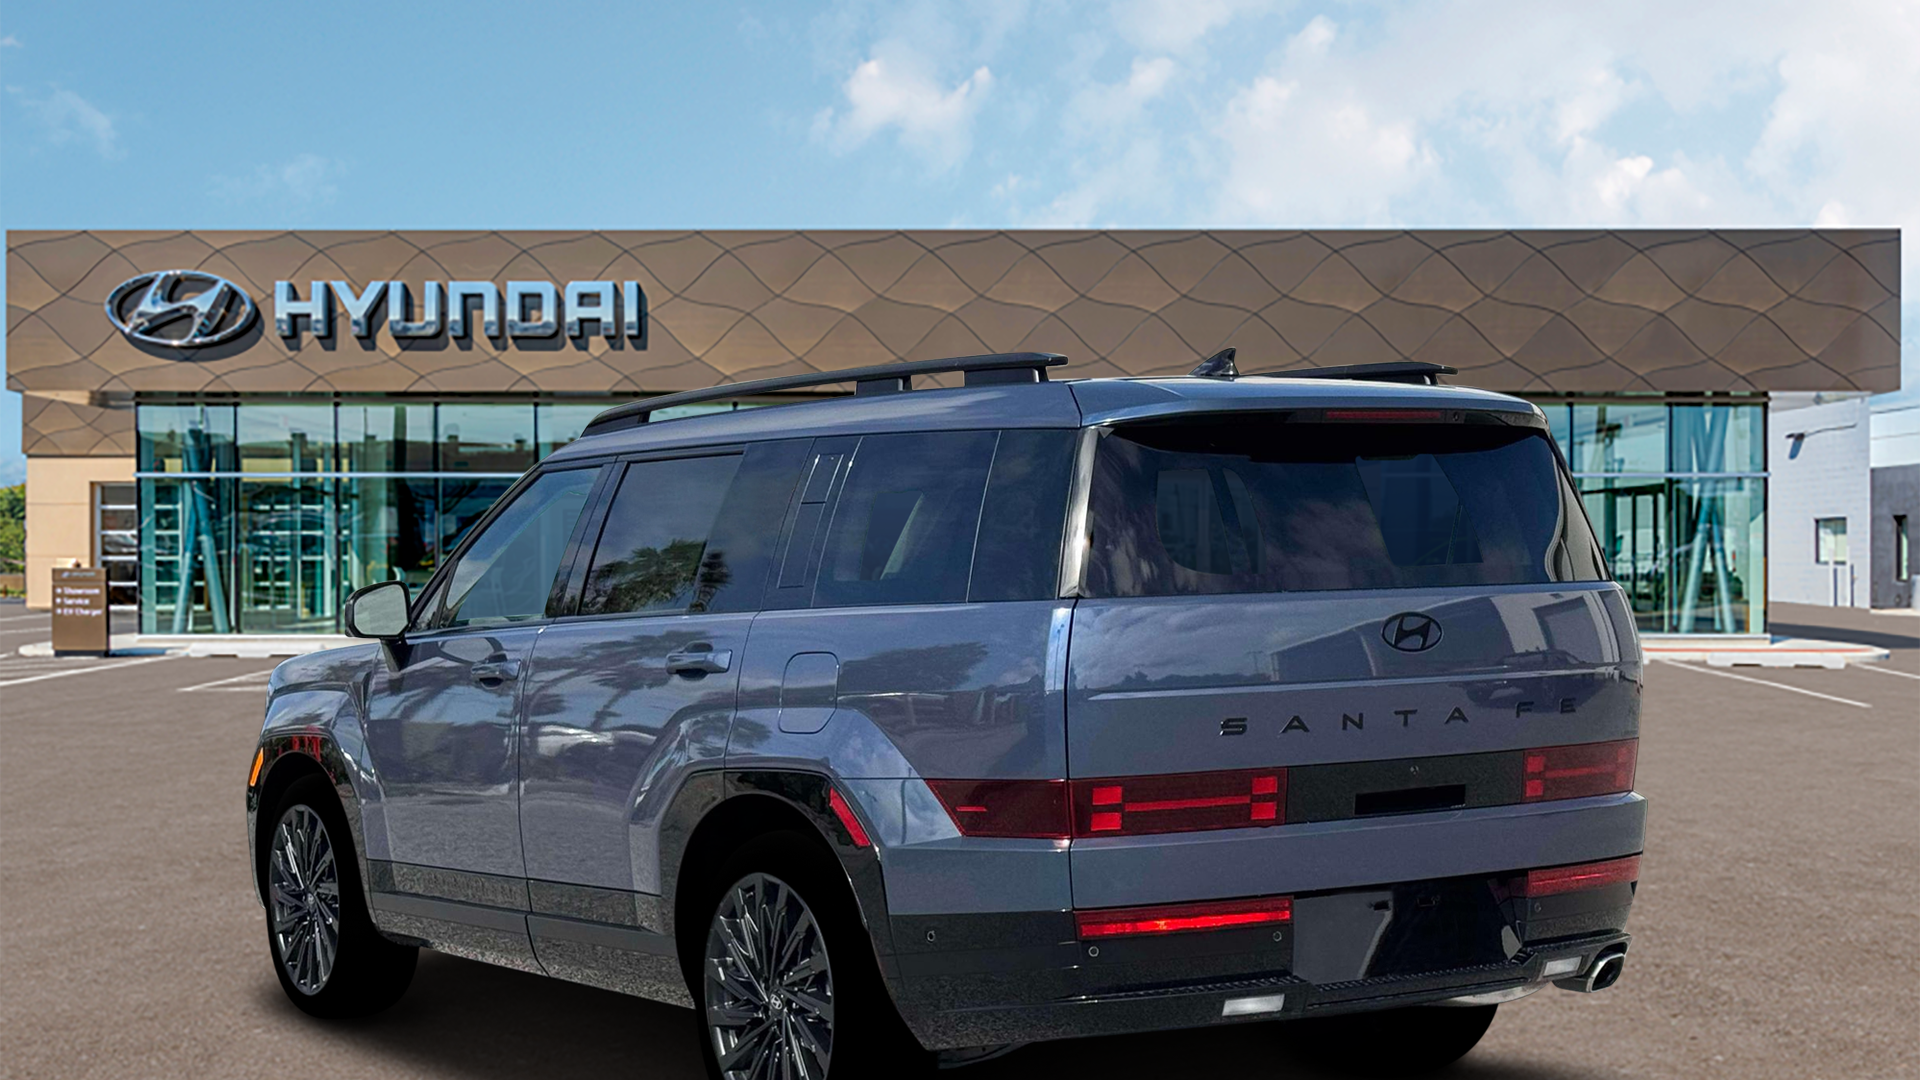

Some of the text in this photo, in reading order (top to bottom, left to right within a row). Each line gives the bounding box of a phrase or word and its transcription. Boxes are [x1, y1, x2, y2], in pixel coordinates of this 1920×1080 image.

[274, 280, 641, 340] HYUNDAI
[1218, 697, 1577, 736] SANTA FE
